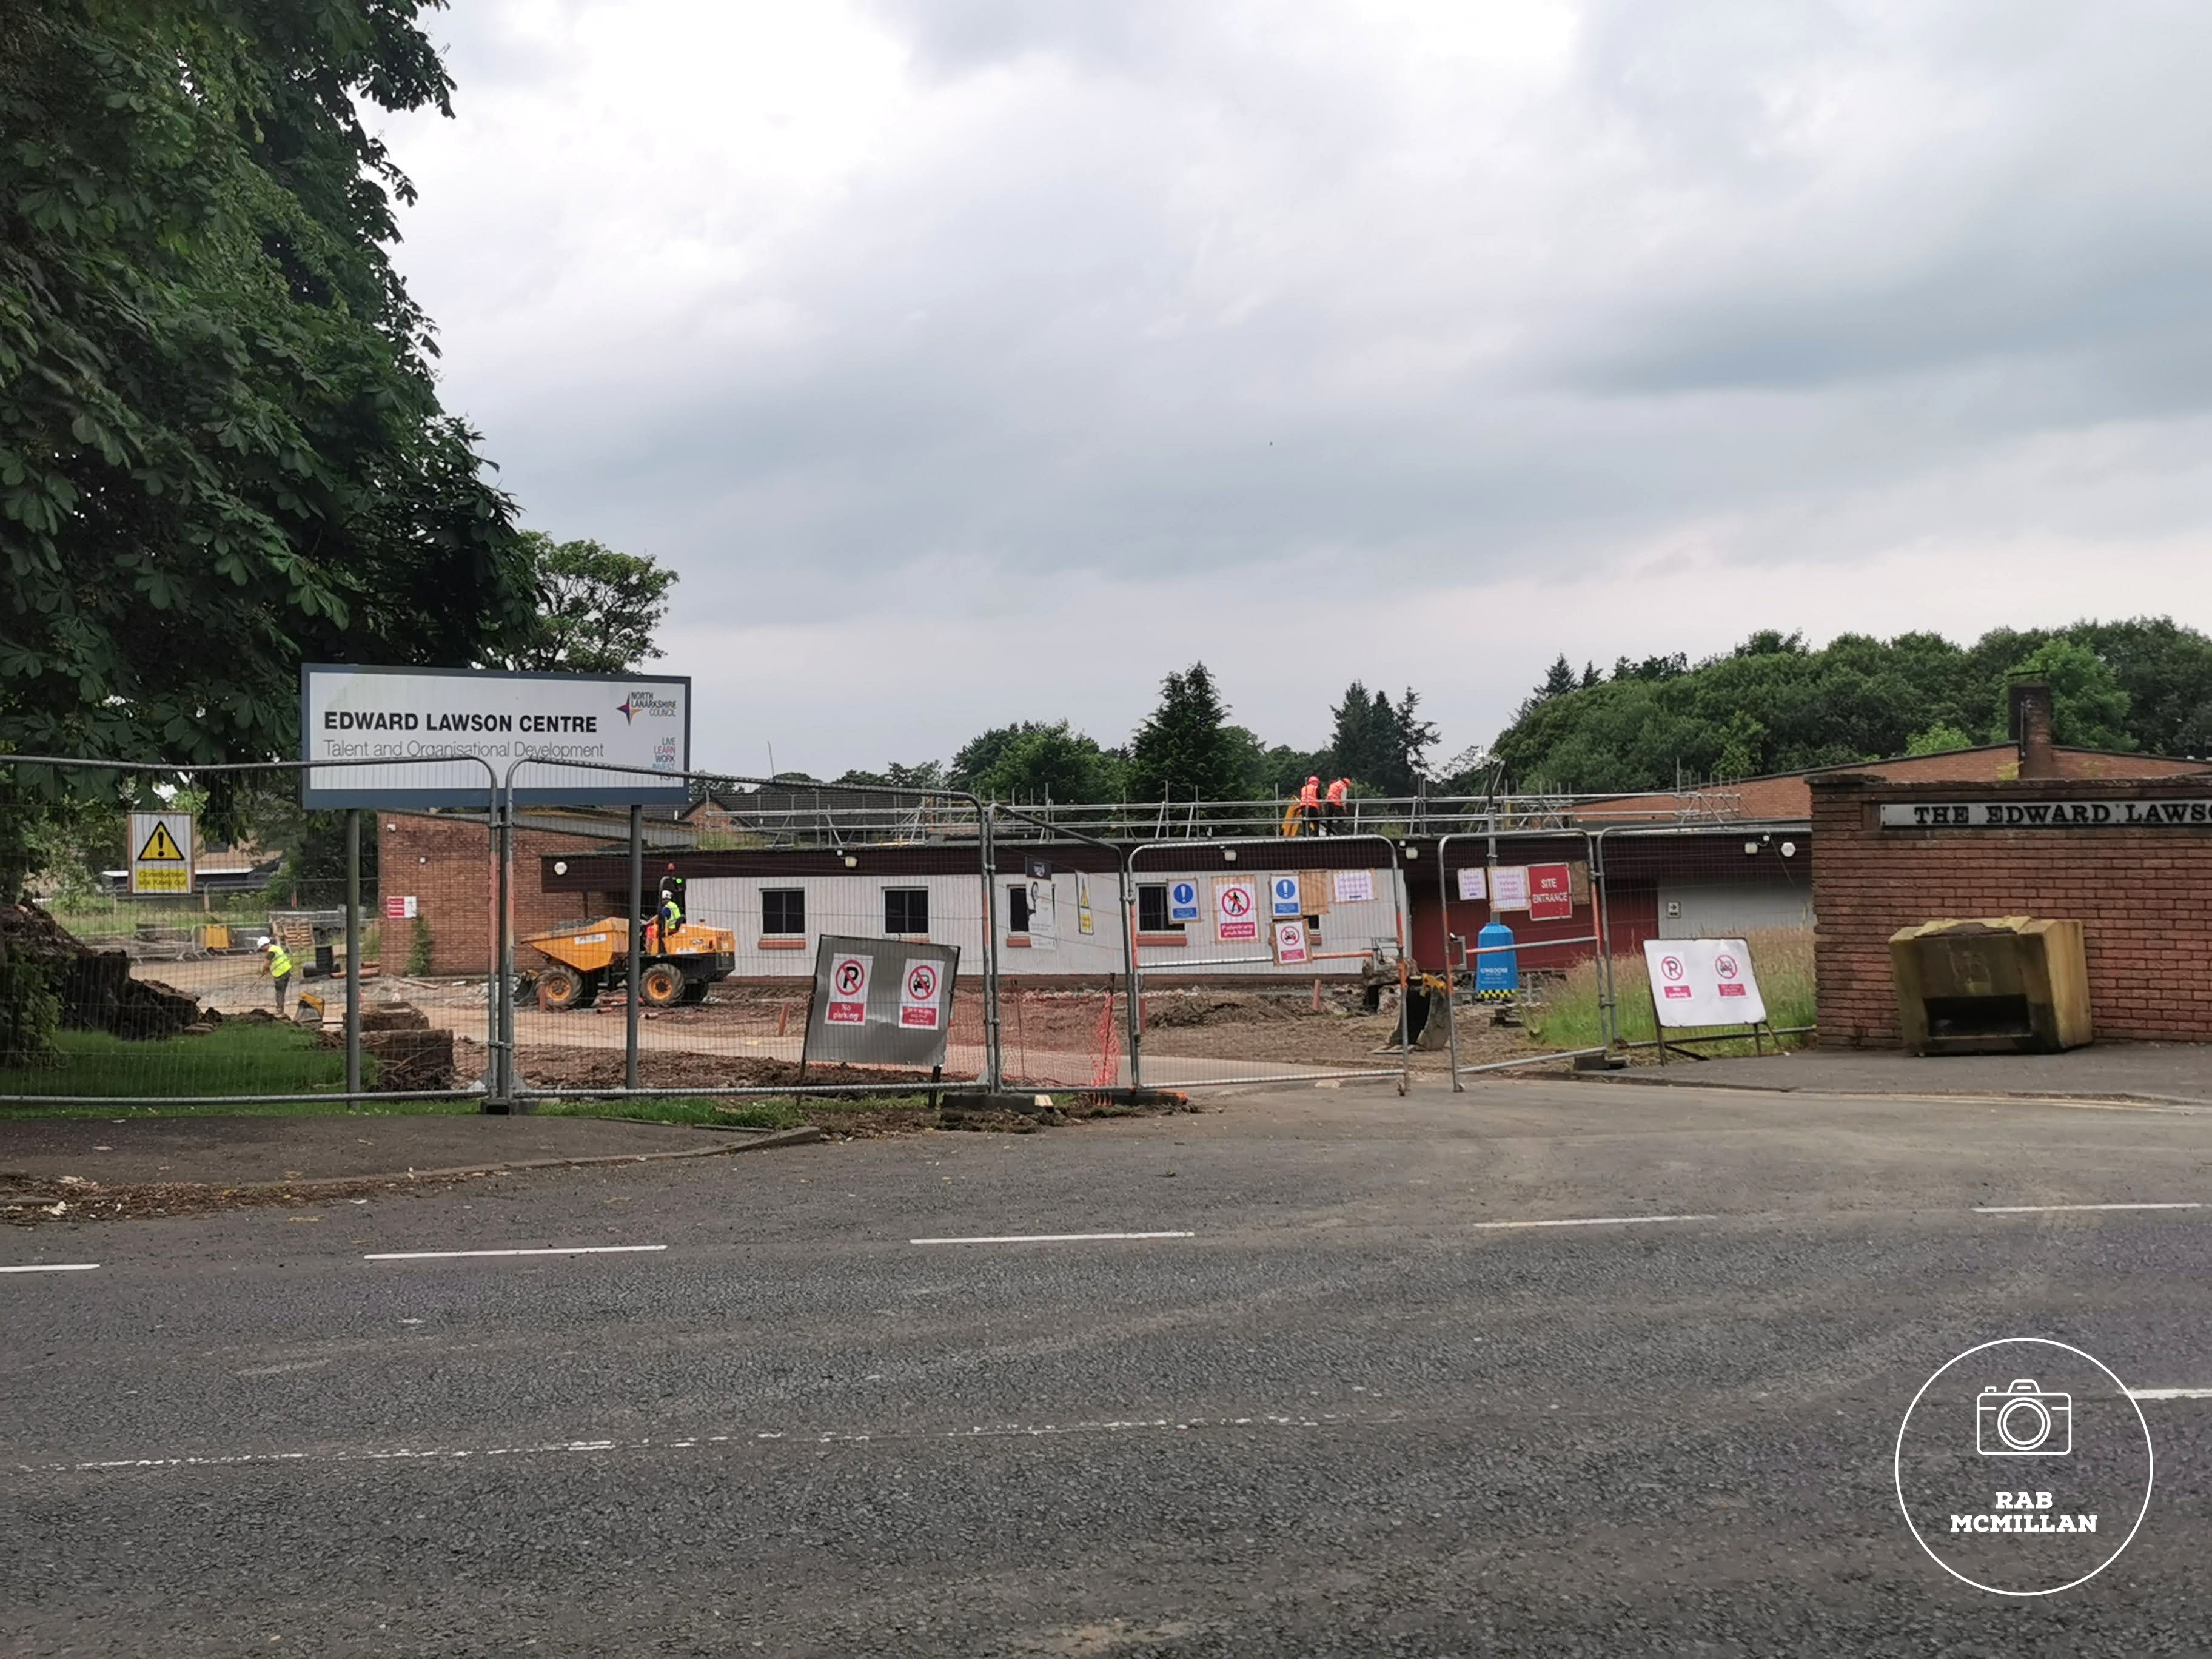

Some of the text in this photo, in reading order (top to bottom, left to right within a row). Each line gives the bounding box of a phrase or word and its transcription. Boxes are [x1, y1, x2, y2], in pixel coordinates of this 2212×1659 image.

[631, 699, 677, 709] LANARKSHIRE
[649, 708, 677, 717] COUNCIL
[324, 711, 597, 733] EDWARD LAWSON CENTRE
[661, 737, 677, 746] LIVE
[323, 739, 604, 759] Talent and Organisational Development
[654, 746, 676, 755] LEARN
[655, 754, 675, 763] WORK
[1914, 803, 2212, 824] THE EDWARD LAWS
[1541, 877, 1557, 889] SITE
[1532, 892, 1568, 903] ENTRANCE
[833, 1011, 859, 1021] parking
